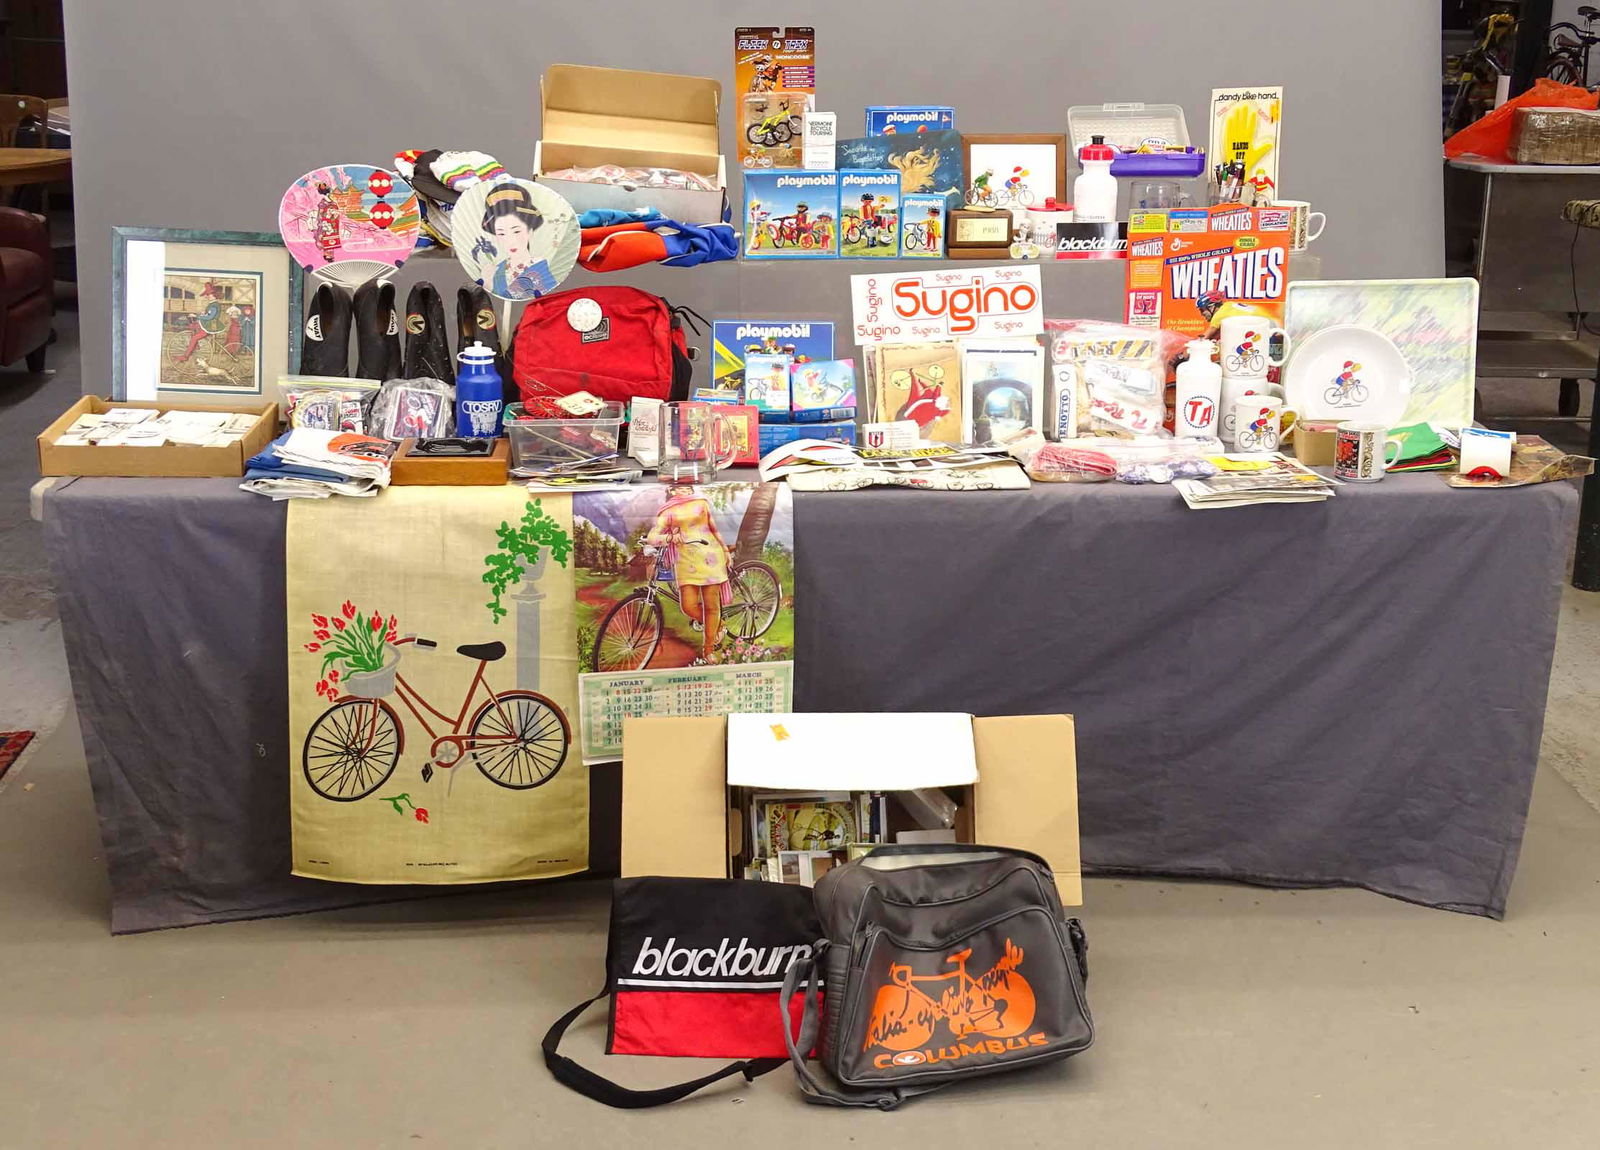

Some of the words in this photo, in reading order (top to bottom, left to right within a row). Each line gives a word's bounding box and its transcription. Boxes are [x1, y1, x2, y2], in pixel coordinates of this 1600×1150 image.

[1218, 93, 1241, 102] dandy
[1242, 92, 1257, 100] bike
[886, 111, 939, 124] playmobil
[1233, 142, 1249, 150] HANDS
[777, 174, 836, 188] playmobil
[842, 174, 898, 187] playmobil
[905, 199, 944, 207] playmobil
[1211, 211, 1252, 231] WHEATIES
[1132, 241, 1164, 256] WHEATIES
[1191, 252, 1211, 260] WHOLE
[1211, 247, 1231, 256] GRAIN
[935, 273, 963, 284] Sugino
[994, 269, 1022, 280] Sugino
[1171, 247, 1285, 300] WHEATIES
[866, 278, 883, 323] Sugino
[895, 279, 1036, 332] Sugino
[736, 324, 811, 341] playmobil
[857, 325, 901, 341] Sugino
[911, 326, 941, 337] Sugino
[994, 321, 1024, 332] Sugino
[466, 401, 500, 412] TOSRV
[1059, 394, 1069, 439] ENOTTO
[1189, 401, 1212, 426] TA
[874, 1032, 1049, 1069] COLUMBUS
